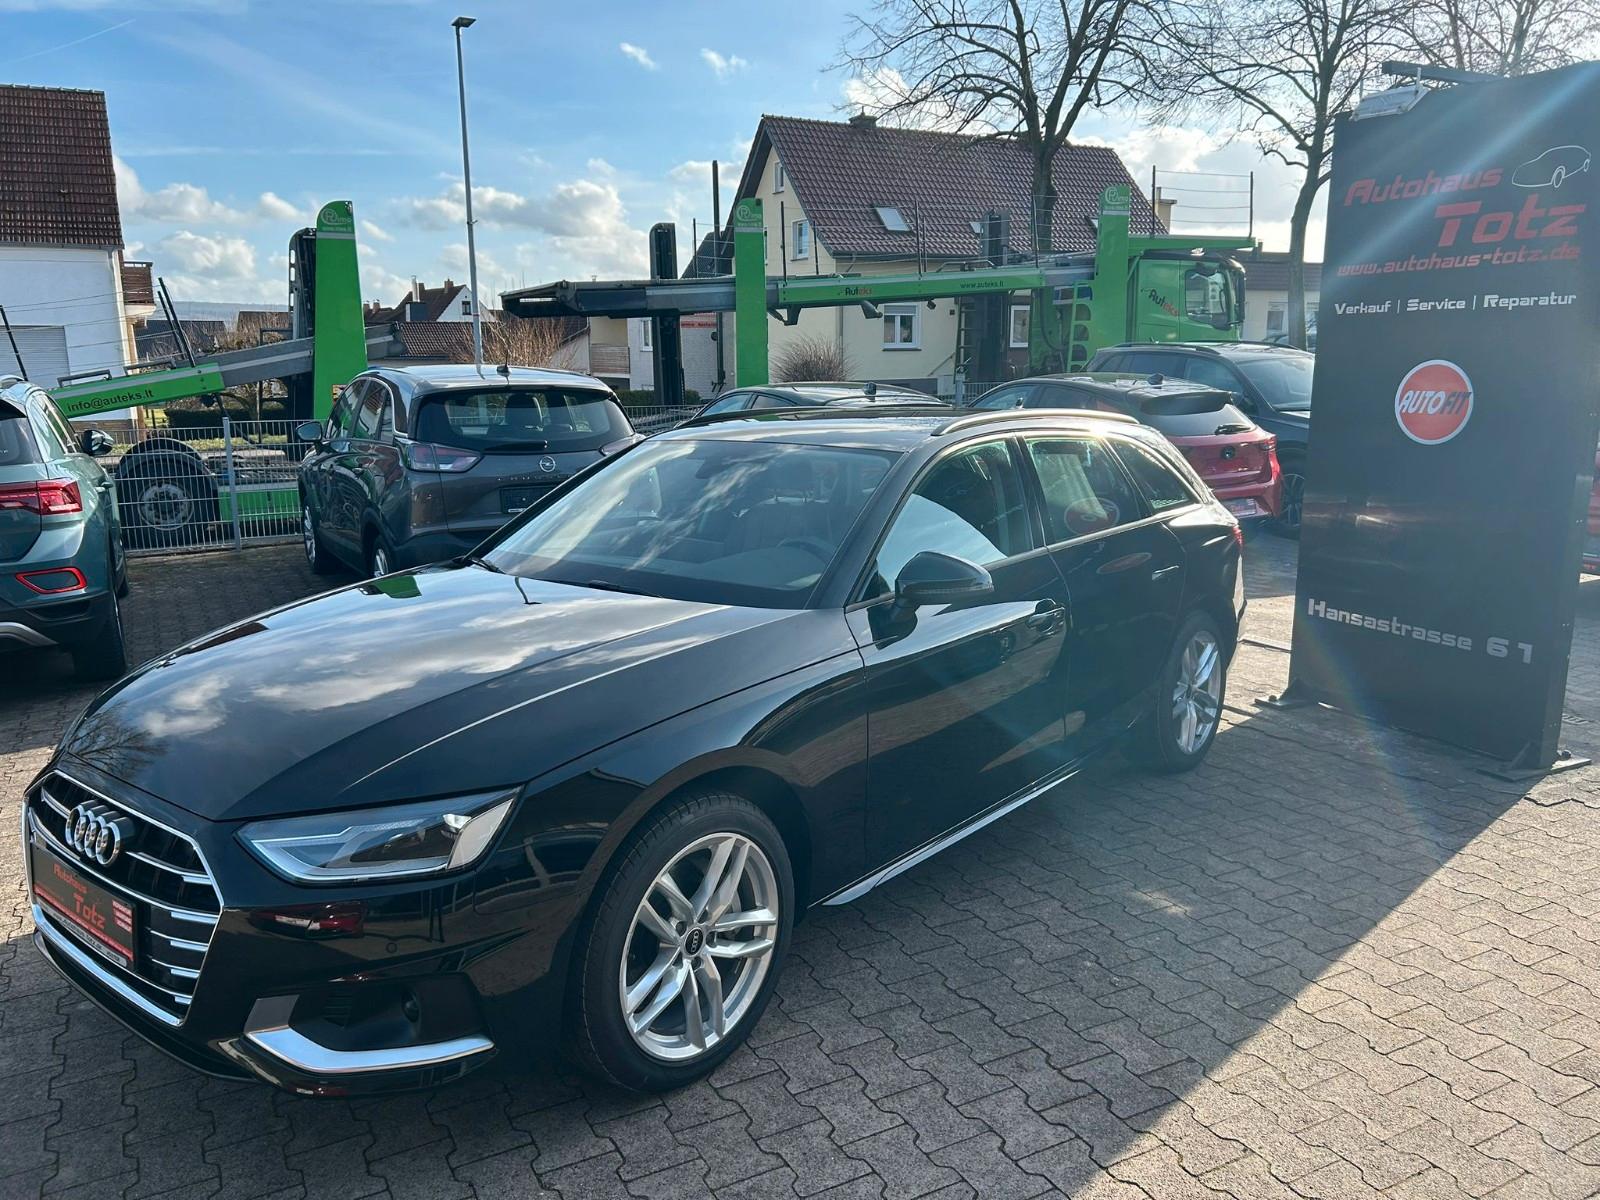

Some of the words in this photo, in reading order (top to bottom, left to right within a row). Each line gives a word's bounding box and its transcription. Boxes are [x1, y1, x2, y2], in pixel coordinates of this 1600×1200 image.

[1344, 167, 1504, 206] Autohaus
[1435, 193, 1586, 247] Totz
[1337, 241, 1581, 277] www.autohaus-totz.de
[1335, 300, 1391, 315] Verkauf
[1406, 298, 1466, 312] Service
[1483, 292, 1577, 310] Reparatur
[67, 389, 154, 412] info@auteks.lt
[1400, 390, 1472, 415] AUTOFIT
[1308, 598, 1472, 651] Hansastrasse
[1486, 636, 1533, 664] 61
[73, 892, 106, 929] Totz
